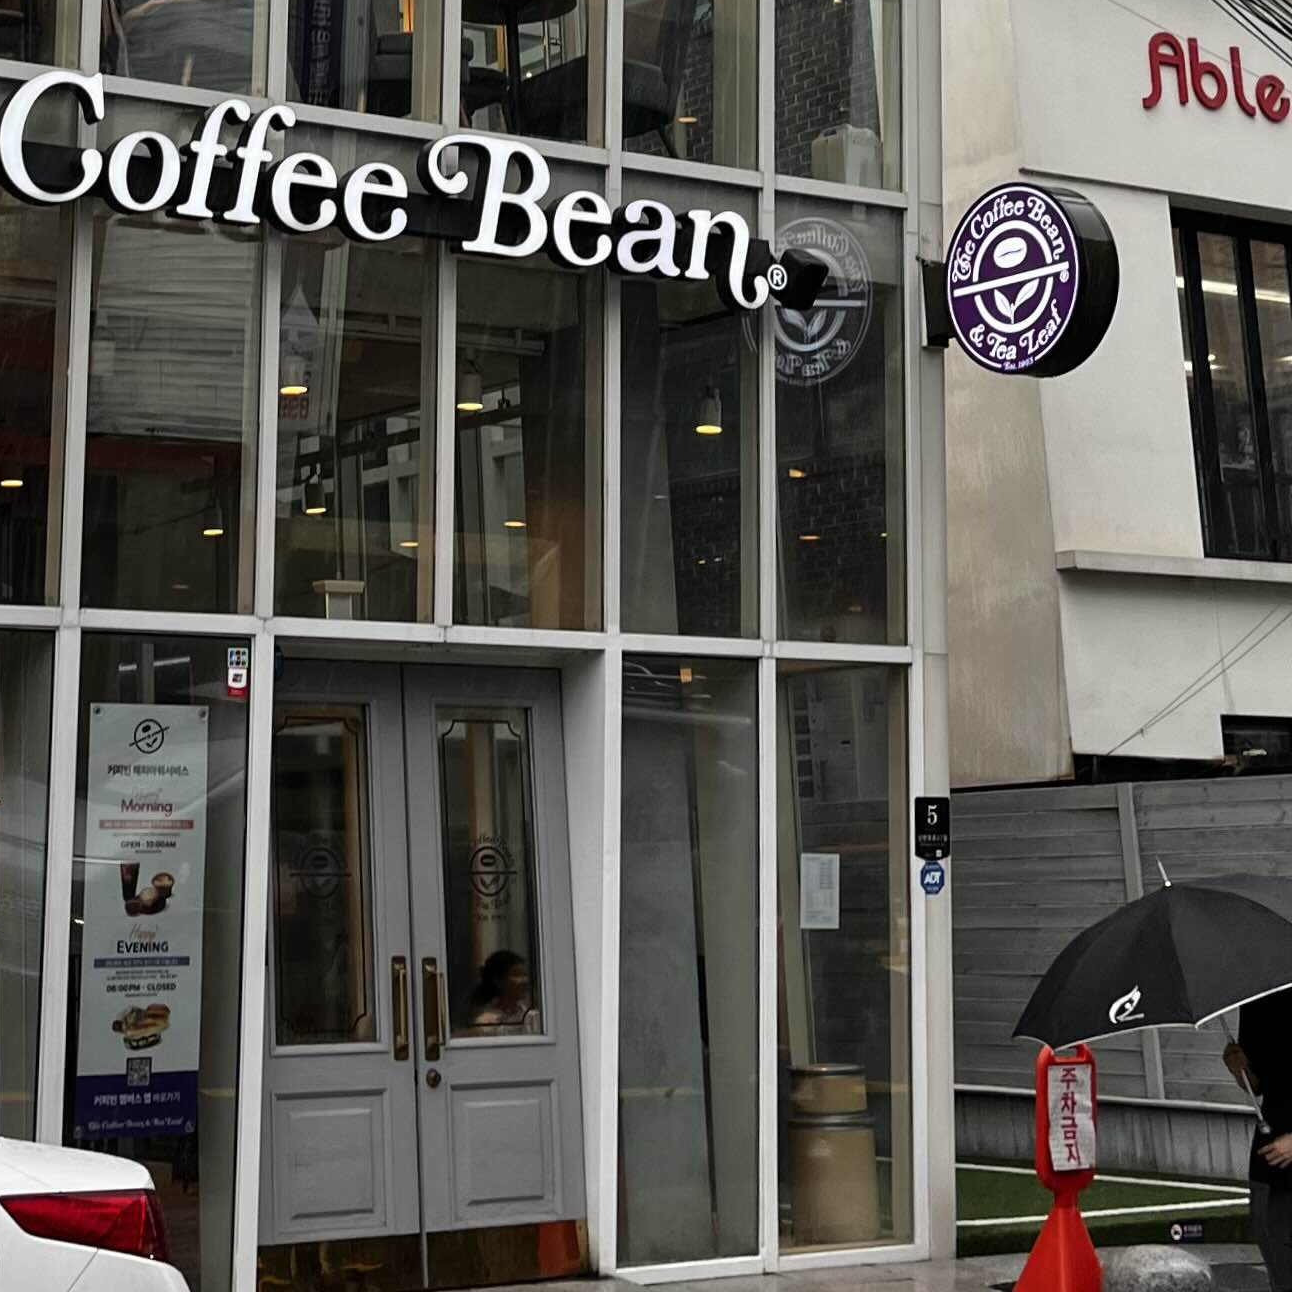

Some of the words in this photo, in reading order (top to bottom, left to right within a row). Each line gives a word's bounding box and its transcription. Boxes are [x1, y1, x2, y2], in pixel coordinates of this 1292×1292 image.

[1142, 32, 1291, 123] Able
[0, 70, 408, 242] Coffee
[427, 133, 769, 310] Bean
[952, 240, 976, 283] The
[970, 194, 1025, 240] Coffee
[1027, 196, 1066, 260] Bean
[969, 323, 985, 348] &
[987, 333, 1017, 359] Tea
[1019, 298, 1061, 355] Leaf
[121, 798, 173, 817] Morning
[927, 804, 938, 826] 5
[924, 871, 942, 884] ADT
[1060, 1067, 1082, 1166] 주차금지
